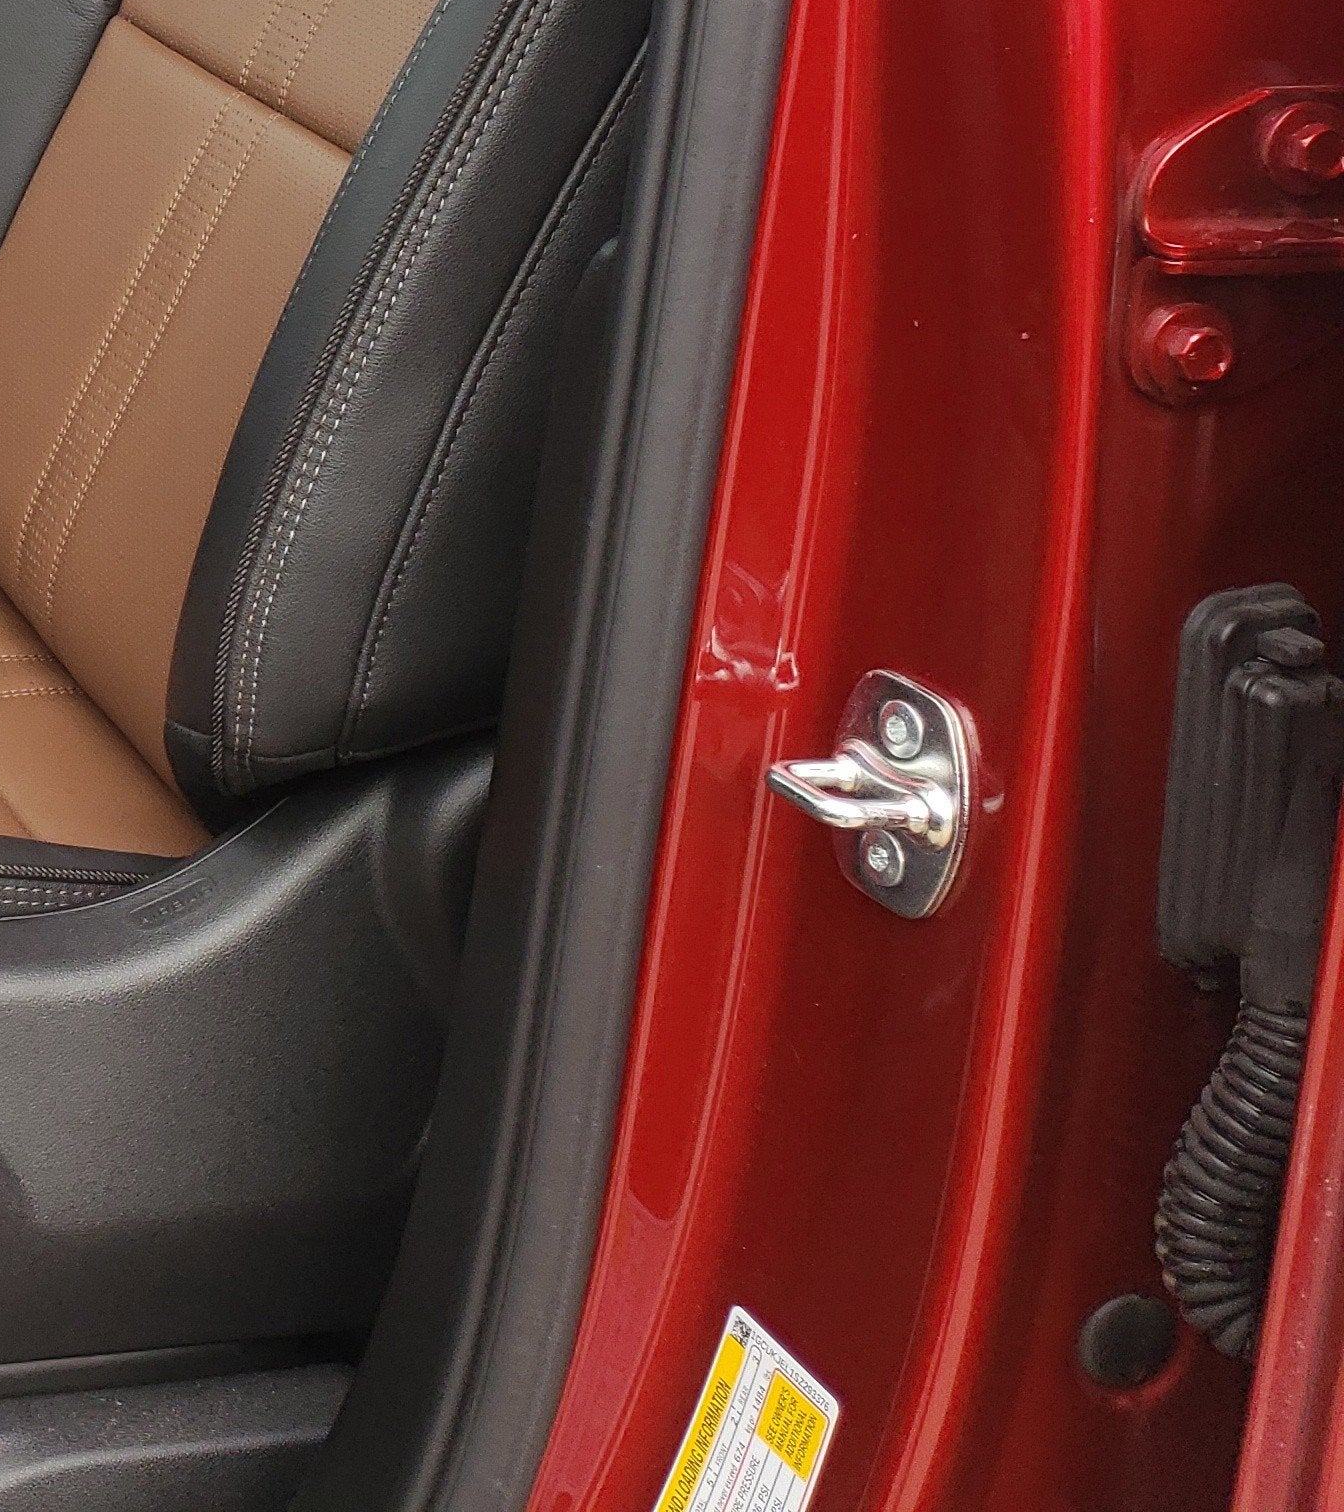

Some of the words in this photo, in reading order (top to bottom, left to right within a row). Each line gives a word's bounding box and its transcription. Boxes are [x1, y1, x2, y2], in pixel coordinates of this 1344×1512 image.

[675, 1448, 704, 1501] LOADING
[694, 1377, 732, 1456] INFORMATION
[765, 1426, 777, 1445] SEE
[772, 1387, 790, 1427] OWNER'S
[775, 1417, 792, 1452] MANUAL
[787, 1396, 798, 1417] FOR
[785, 1409, 807, 1459] ADDITIONAL
[793, 1413, 817, 1472] INFORMATION
[738, 1455, 760, 1501] PRESSURE
[758, 1484, 770, 1503] PSI
